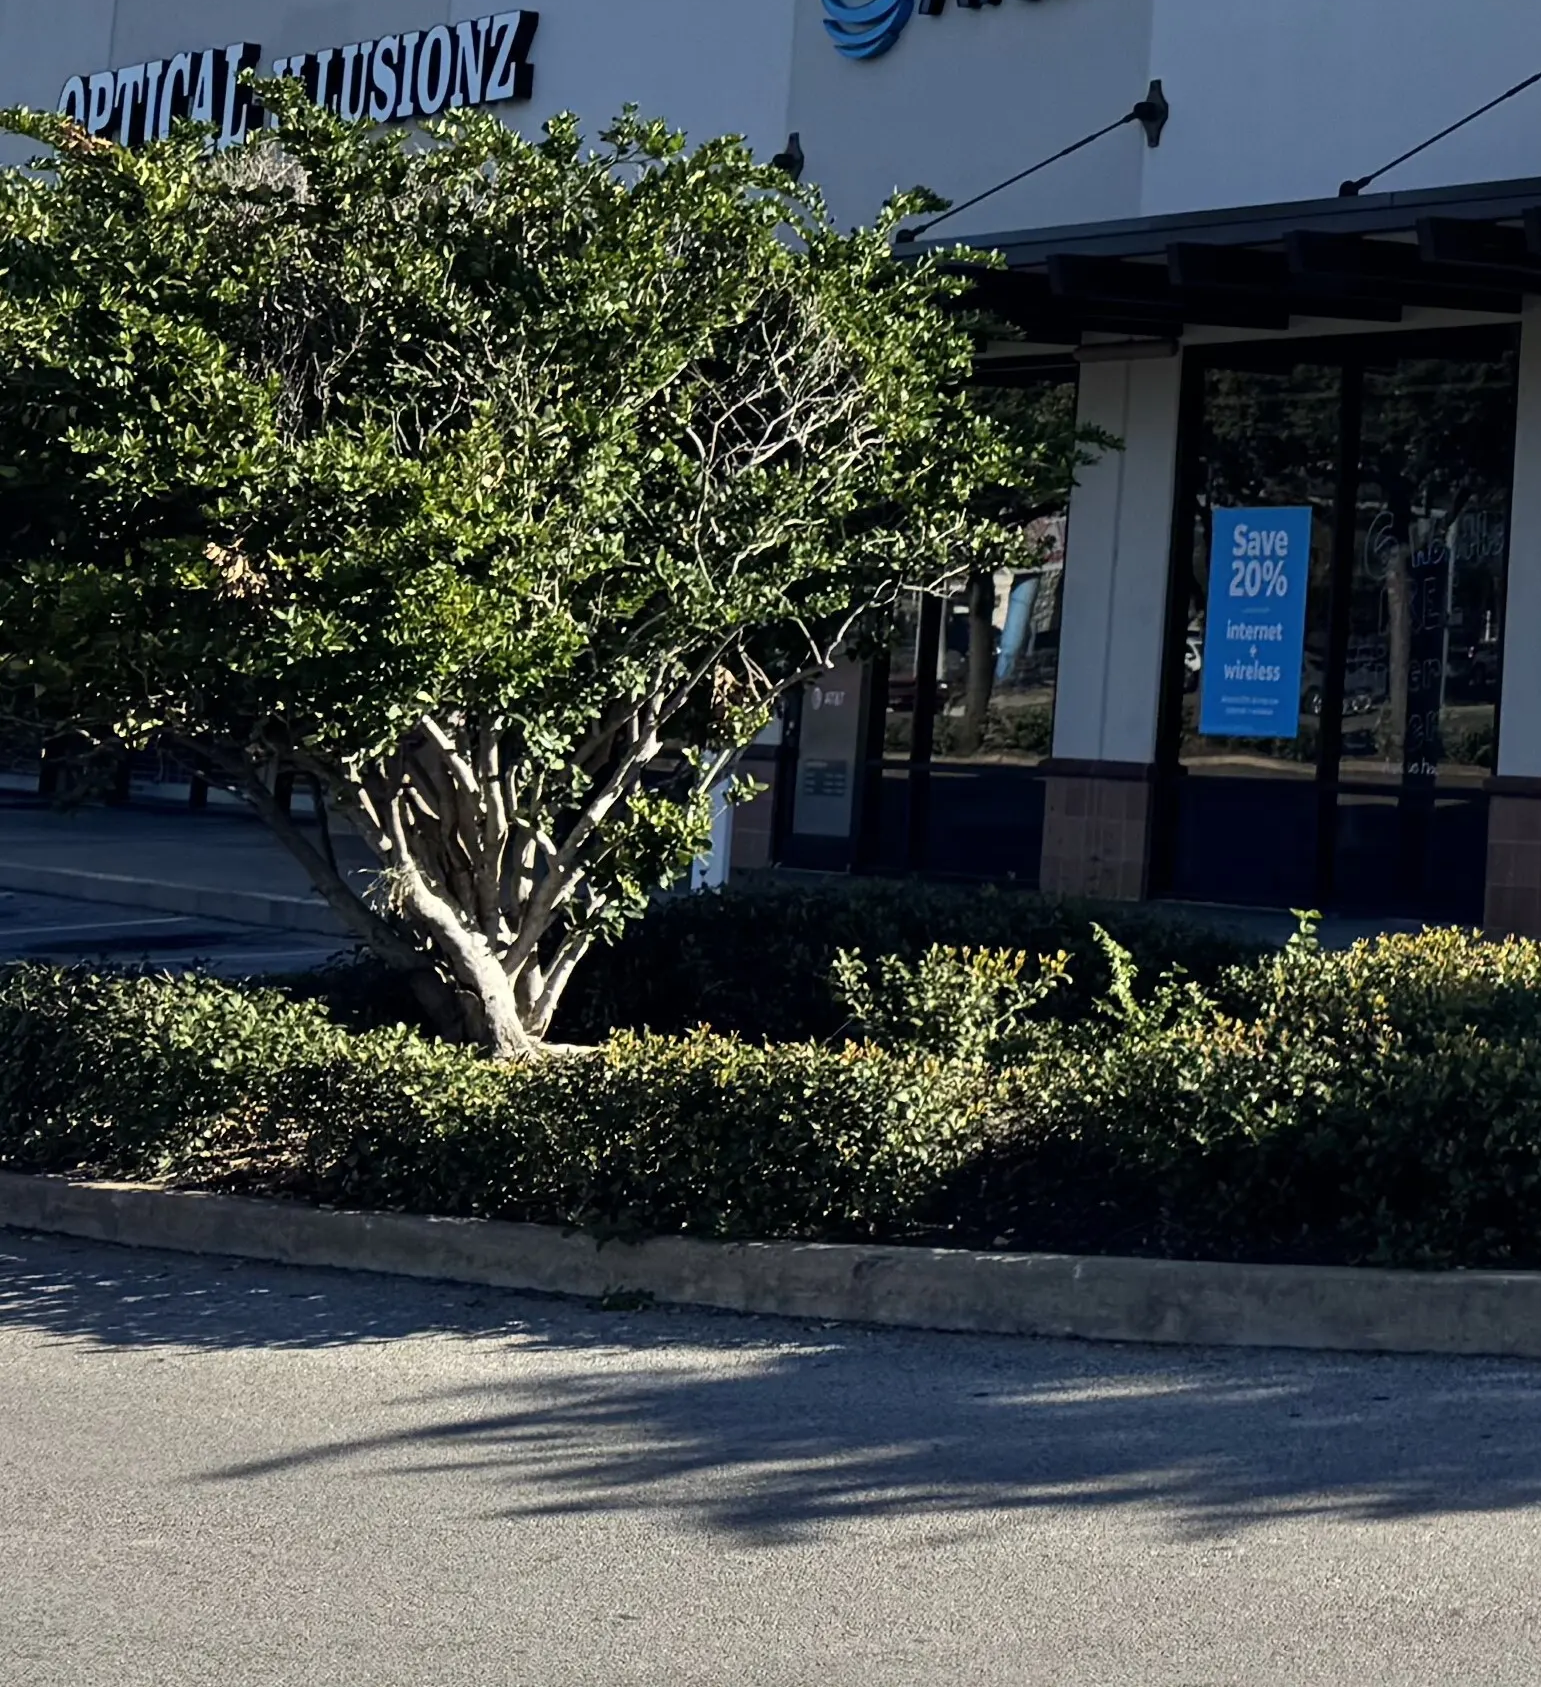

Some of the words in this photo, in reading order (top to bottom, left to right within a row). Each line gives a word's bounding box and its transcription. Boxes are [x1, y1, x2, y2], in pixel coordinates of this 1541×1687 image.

[58, 42, 258, 151] OPTICAL
[1232, 522, 1289, 557] Save
[1228, 559, 1289, 598] 20%
[1226, 618, 1284, 642] internet
[1223, 661, 1281, 683] wireless
